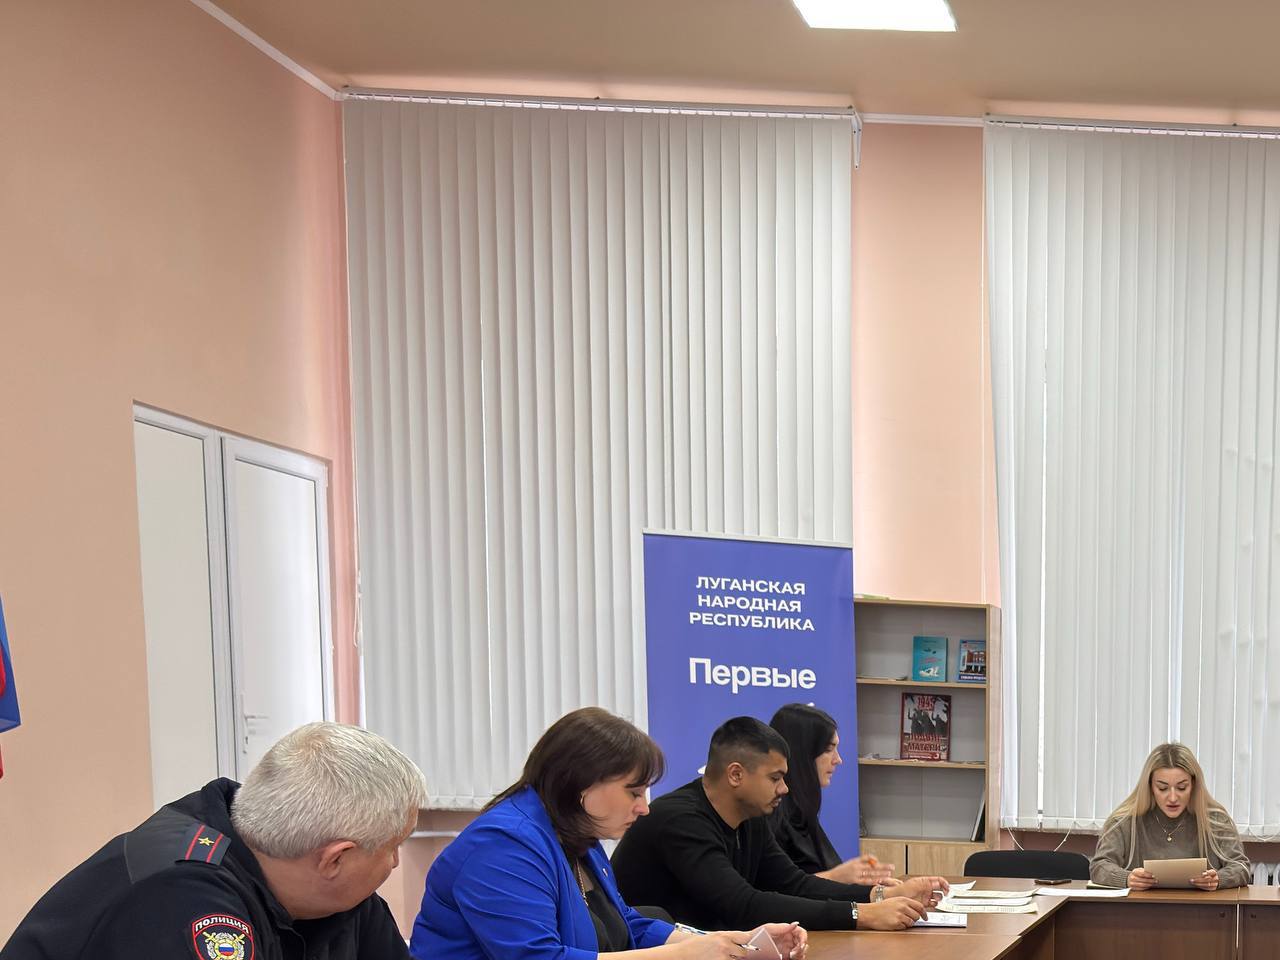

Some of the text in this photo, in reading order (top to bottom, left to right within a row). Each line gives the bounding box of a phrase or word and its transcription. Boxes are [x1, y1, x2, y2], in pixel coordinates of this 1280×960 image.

[696, 576, 806, 595] ЛУГАНСКАЯ
[698, 594, 801, 613] НАРОДНАЯ
[689, 612, 815, 631] РЕСПУБЛИКА
[689, 657, 817, 694] Первые
[195, 916, 249, 934] ПОЛИЦИЯ
